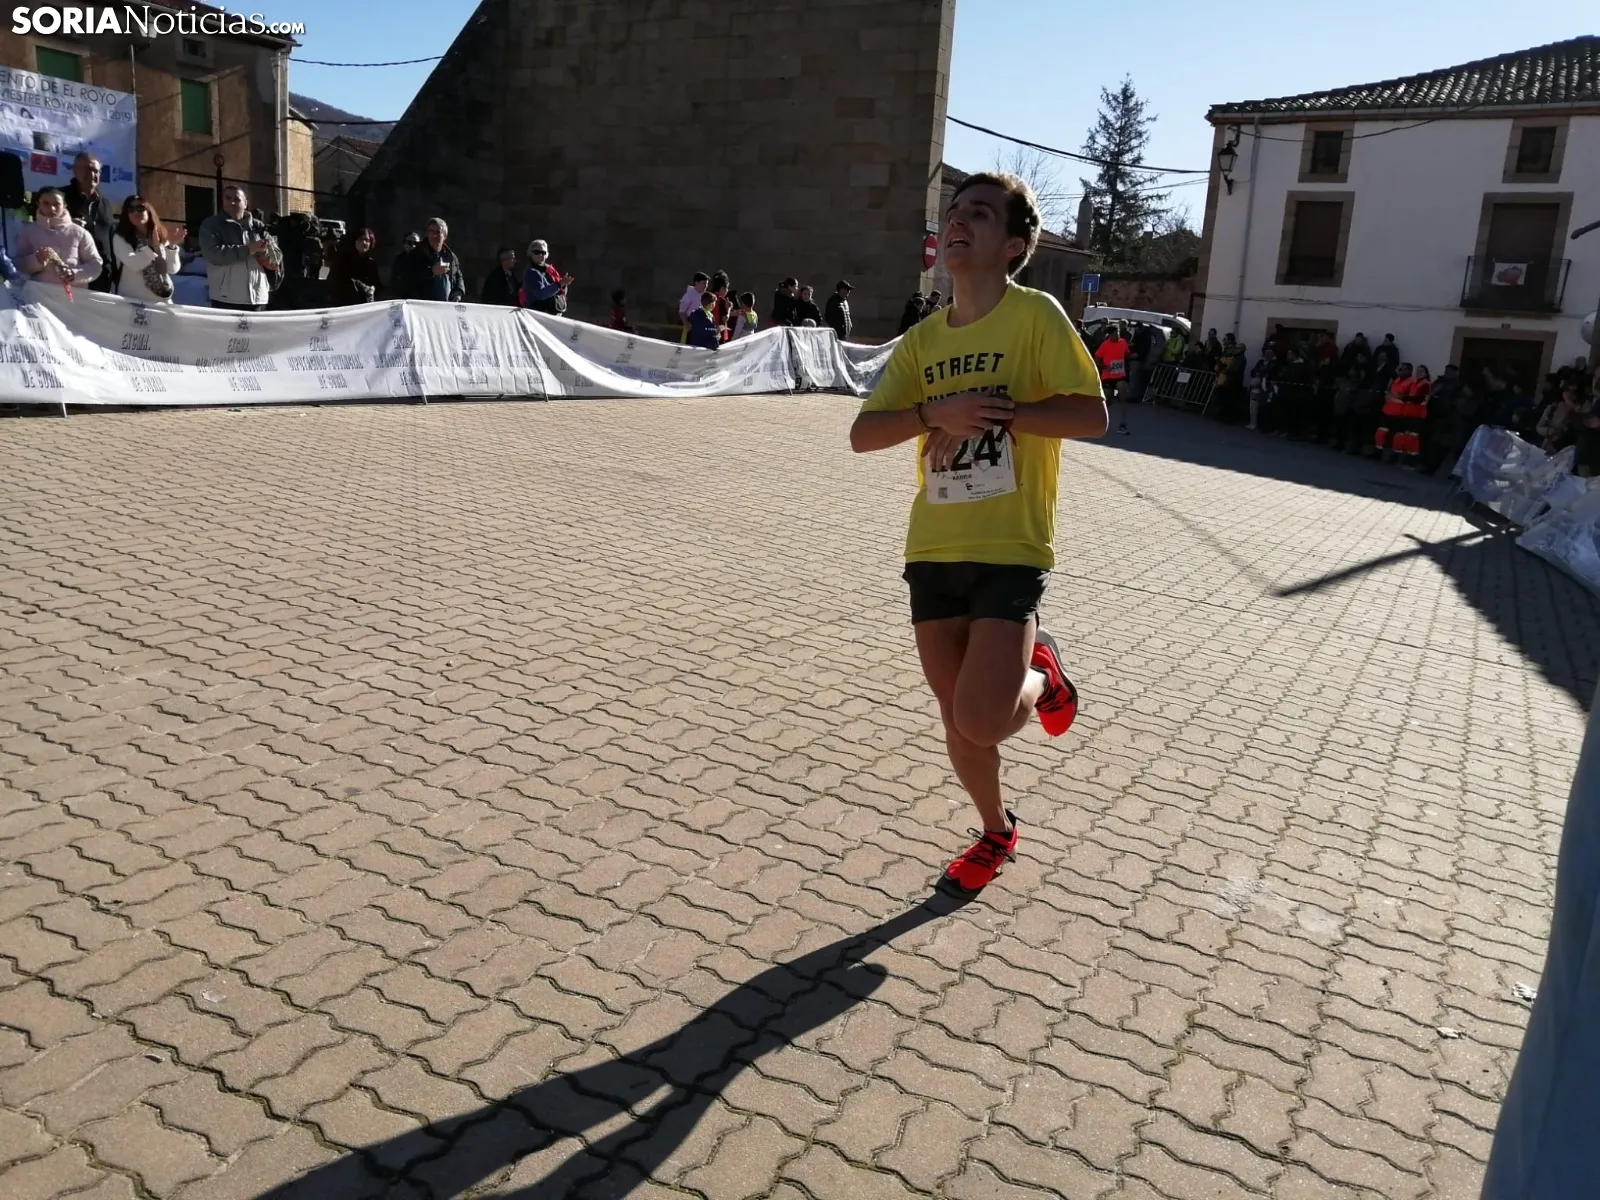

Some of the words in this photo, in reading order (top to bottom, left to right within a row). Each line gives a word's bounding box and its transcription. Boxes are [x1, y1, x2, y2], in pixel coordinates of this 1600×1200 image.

[41, 79, 58, 94] DE
[63, 83, 76, 98] EL
[80, 87, 117, 106] ROYO
[110, 110, 132, 122] 2019
[923, 352, 1005, 386] STREET
